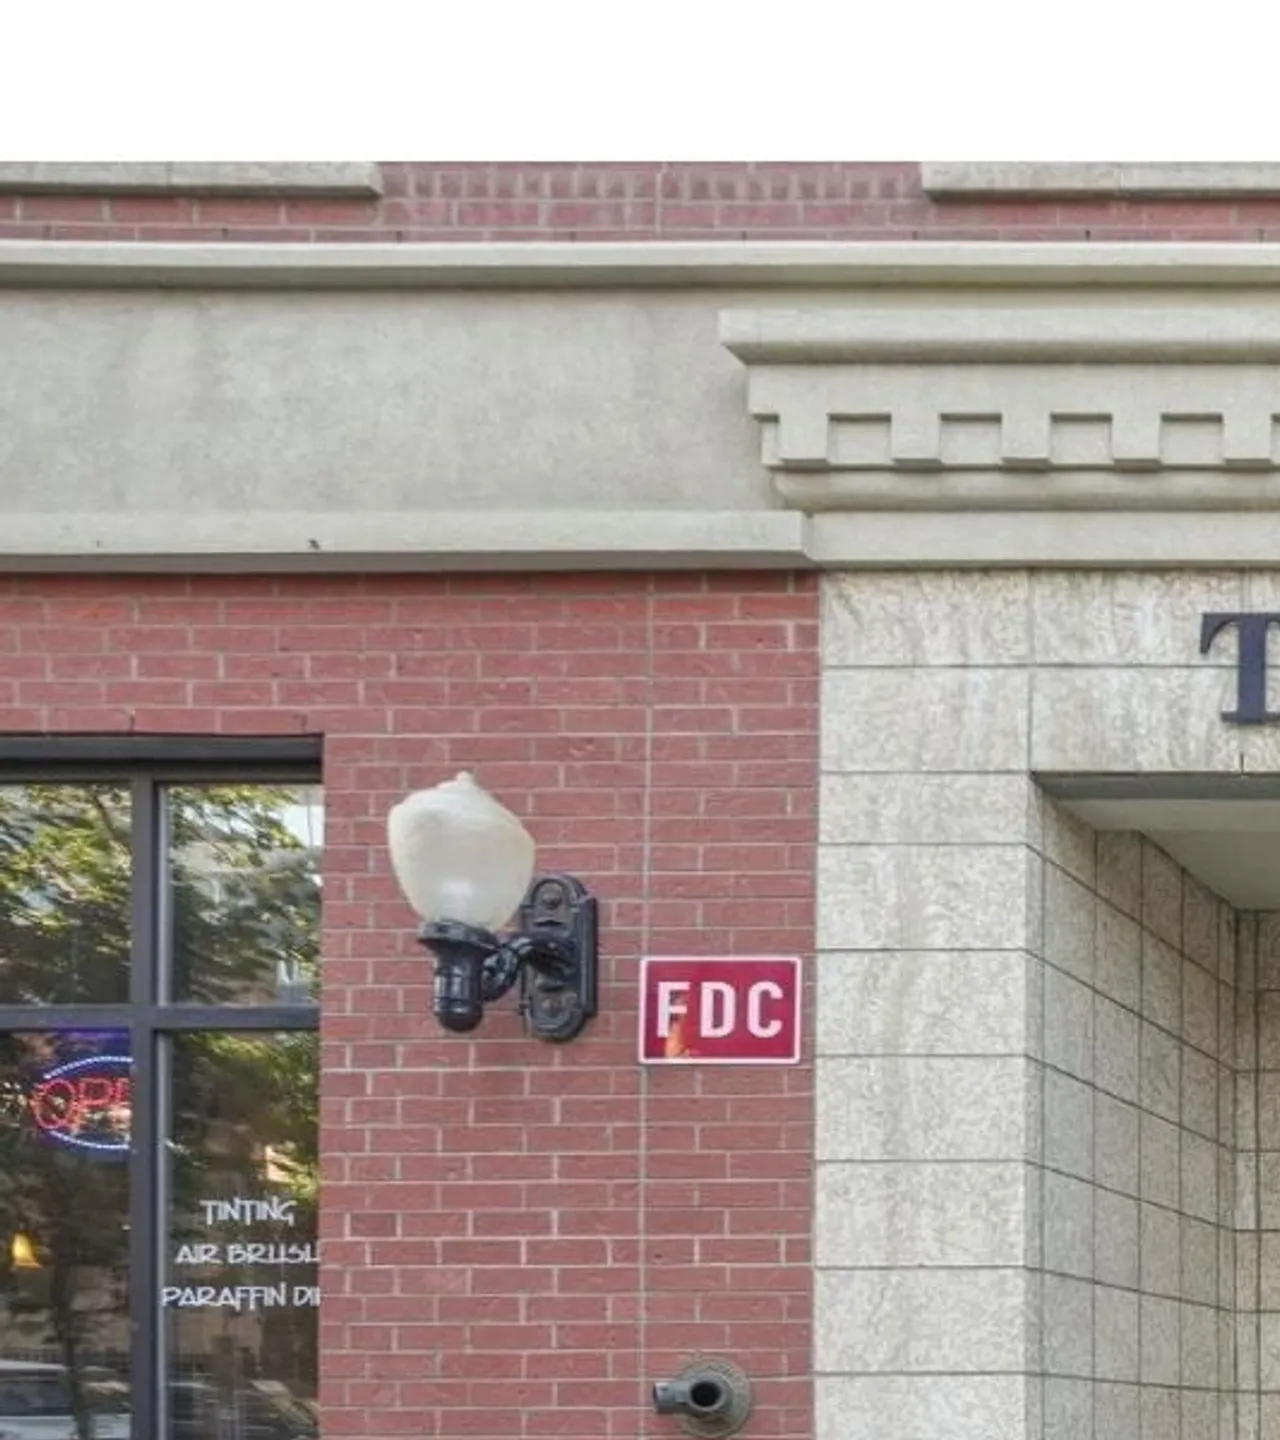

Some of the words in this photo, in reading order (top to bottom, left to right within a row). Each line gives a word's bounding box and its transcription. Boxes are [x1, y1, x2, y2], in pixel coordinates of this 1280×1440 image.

[656, 980, 784, 1039] FDC
[200, 1197, 297, 1227] TINTING
[174, 1243, 223, 1265] AIR
[161, 1282, 287, 1312] PARAFFIN
[293, 1286, 320, 1307] DI
